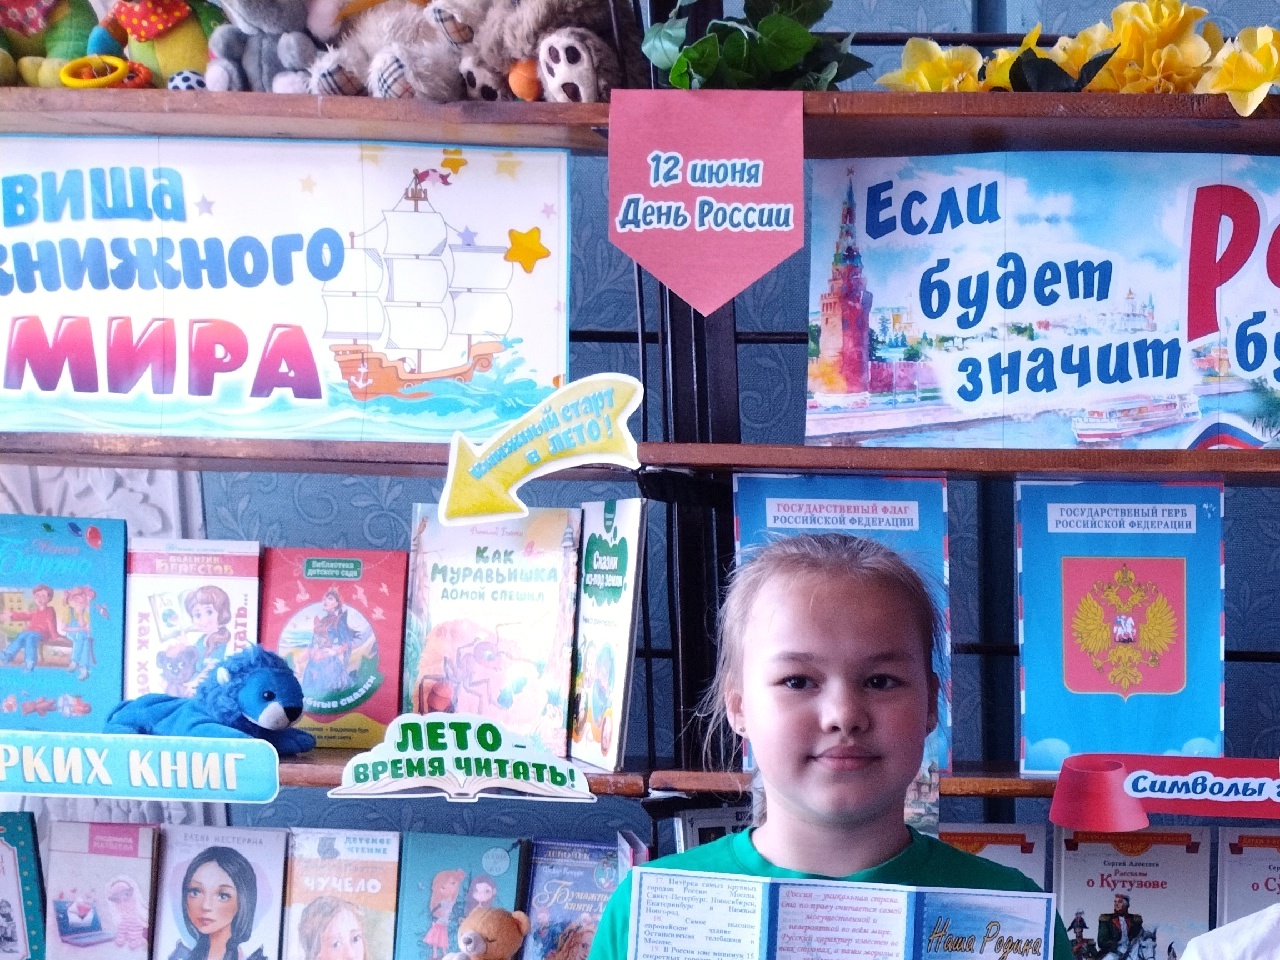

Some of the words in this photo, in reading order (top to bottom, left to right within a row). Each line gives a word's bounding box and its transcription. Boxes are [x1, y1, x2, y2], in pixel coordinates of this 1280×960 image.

[650, 154, 679, 184] 12
[688, 160, 761, 186] июня
[618, 198, 689, 231] День
[698, 199, 793, 229] России
[865, 179, 1001, 240] Если
[919, 251, 1112, 329] будет
[3, 315, 323, 400] МИРА
[957, 337, 1180, 402] значит
[772, 514, 846, 526] РОССИЙСКОЙ
[848, 515, 914, 528] ФЕДЕРАЦИИ
[881, 506, 910, 516] ФЛАГ
[1055, 518, 1126, 530] РОССИЙСКОЙ
[1128, 520, 1193, 532] ФЕДЕРАЦИИ
[1161, 508, 1188, 518] ГЕРБ
[396, 721, 502, 752] ЛЕТО
[129, 750, 246, 791] КНИГ
[353, 757, 447, 784] ВРЕМЯ
[455, 757, 576, 788] ЧИТАТЬ!
[1130, 773, 1268, 798] Символы
[303, 876, 382, 895] ЧУЧЕЛО
[1100, 873, 1168, 892] Кутузове
[927, 915, 976, 954] Наша
